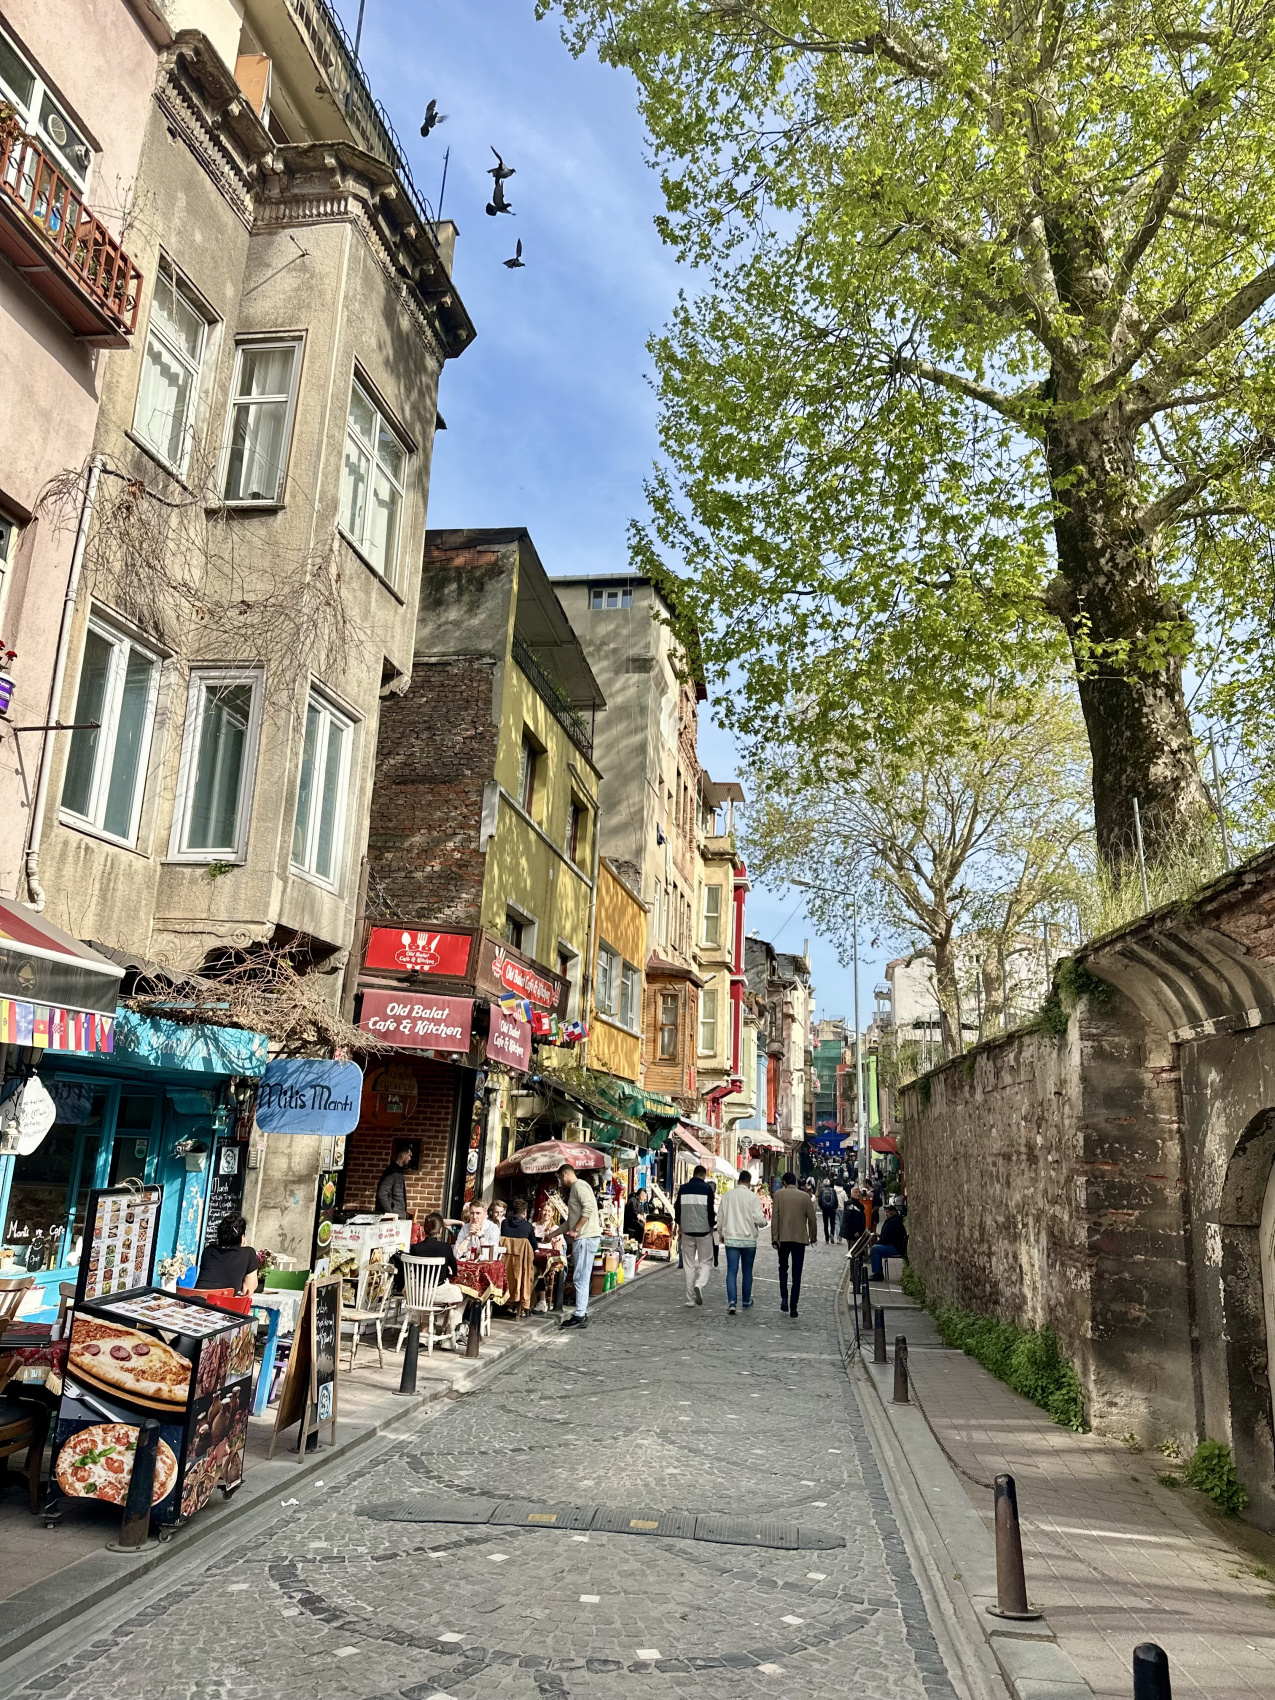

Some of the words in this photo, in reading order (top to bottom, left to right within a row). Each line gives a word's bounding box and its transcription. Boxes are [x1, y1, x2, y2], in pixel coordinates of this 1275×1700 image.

[505, 964, 515, 982] Old
[513, 969, 526, 988] Balat
[525, 975, 534, 994] Cafe
[533, 980, 538, 998] &
[537, 982, 551, 1004] Kitchen
[386, 1002, 411, 1016] Old
[411, 1004, 449, 1019] Balat
[368, 1016, 397, 1032] Cafe
[399, 1019, 412, 1034] &
[414, 1020, 462, 1039] Kitchen
[500, 1020, 509, 1034] Old
[508, 1023, 521, 1039] Balat
[493, 1033, 504, 1048] Cafe
[504, 1037, 509, 1052] &
[509, 1039, 524, 1058] Kitchen
[258, 1082, 306, 1109] Mitis
[49, 1224, 66, 1242] Cafe
